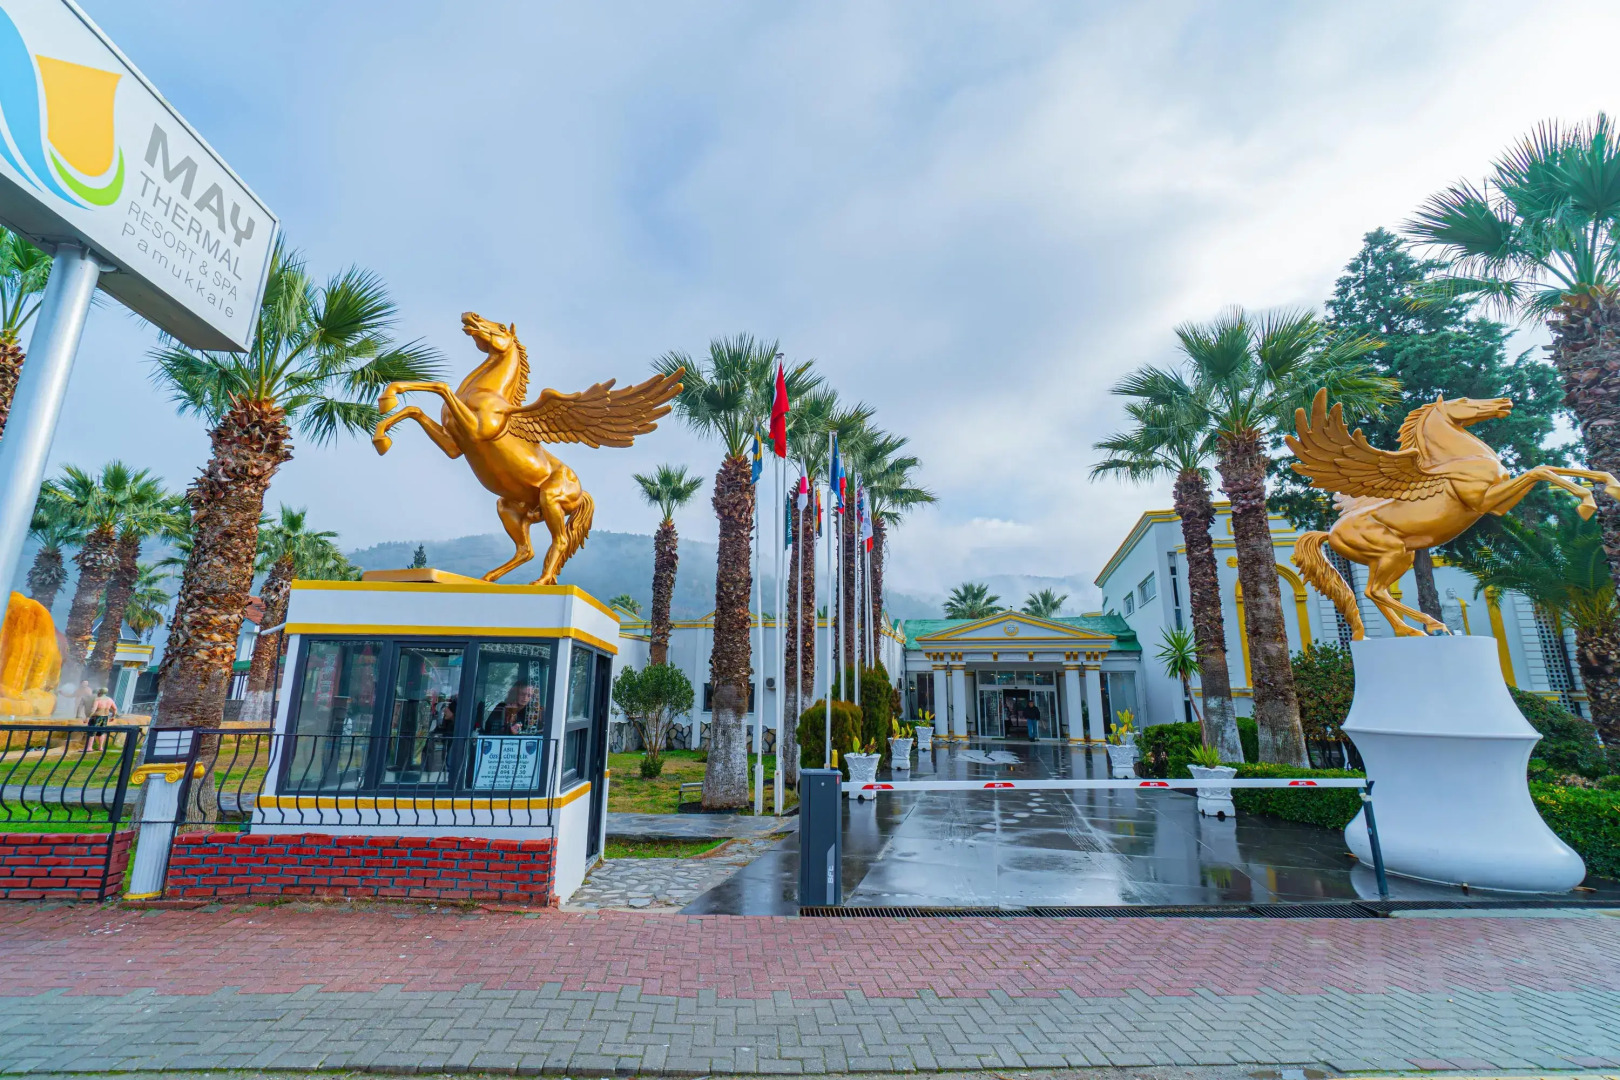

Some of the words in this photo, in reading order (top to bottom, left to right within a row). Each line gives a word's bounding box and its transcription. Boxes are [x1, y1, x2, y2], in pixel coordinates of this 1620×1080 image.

[140, 170, 242, 281] THERMAL
[144, 122, 255, 247] MAY
[121, 222, 234, 318] Pamukkale
[128, 200, 197, 264] RESORT
[198, 260, 208, 278] &
[212, 271, 238, 301] SPA
